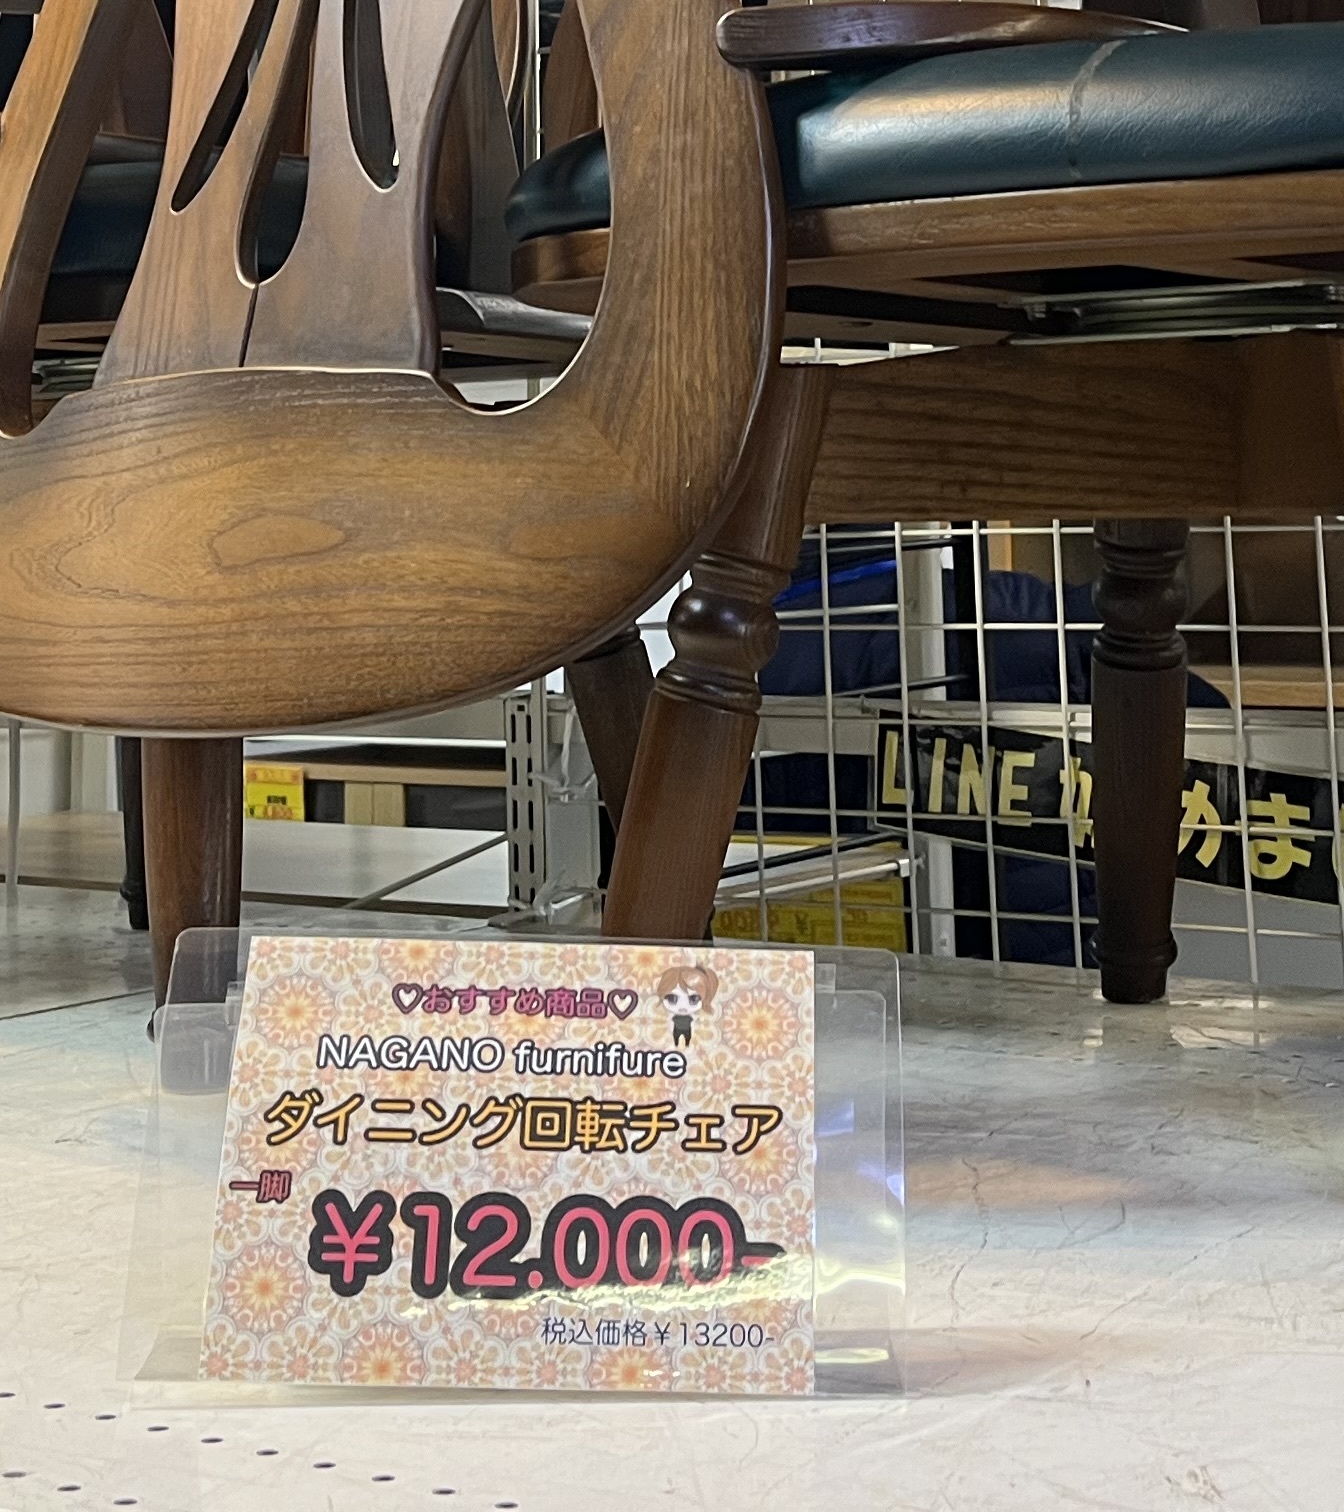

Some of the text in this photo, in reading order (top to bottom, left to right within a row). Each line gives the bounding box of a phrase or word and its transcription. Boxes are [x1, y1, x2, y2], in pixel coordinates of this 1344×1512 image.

[882, 730, 1036, 828] LINE
[316, 1033, 504, 1073] NAGANO
[264, 1091, 784, 1156] ダイニング回転チェア
[229, 1169, 293, 1204] 一脚
